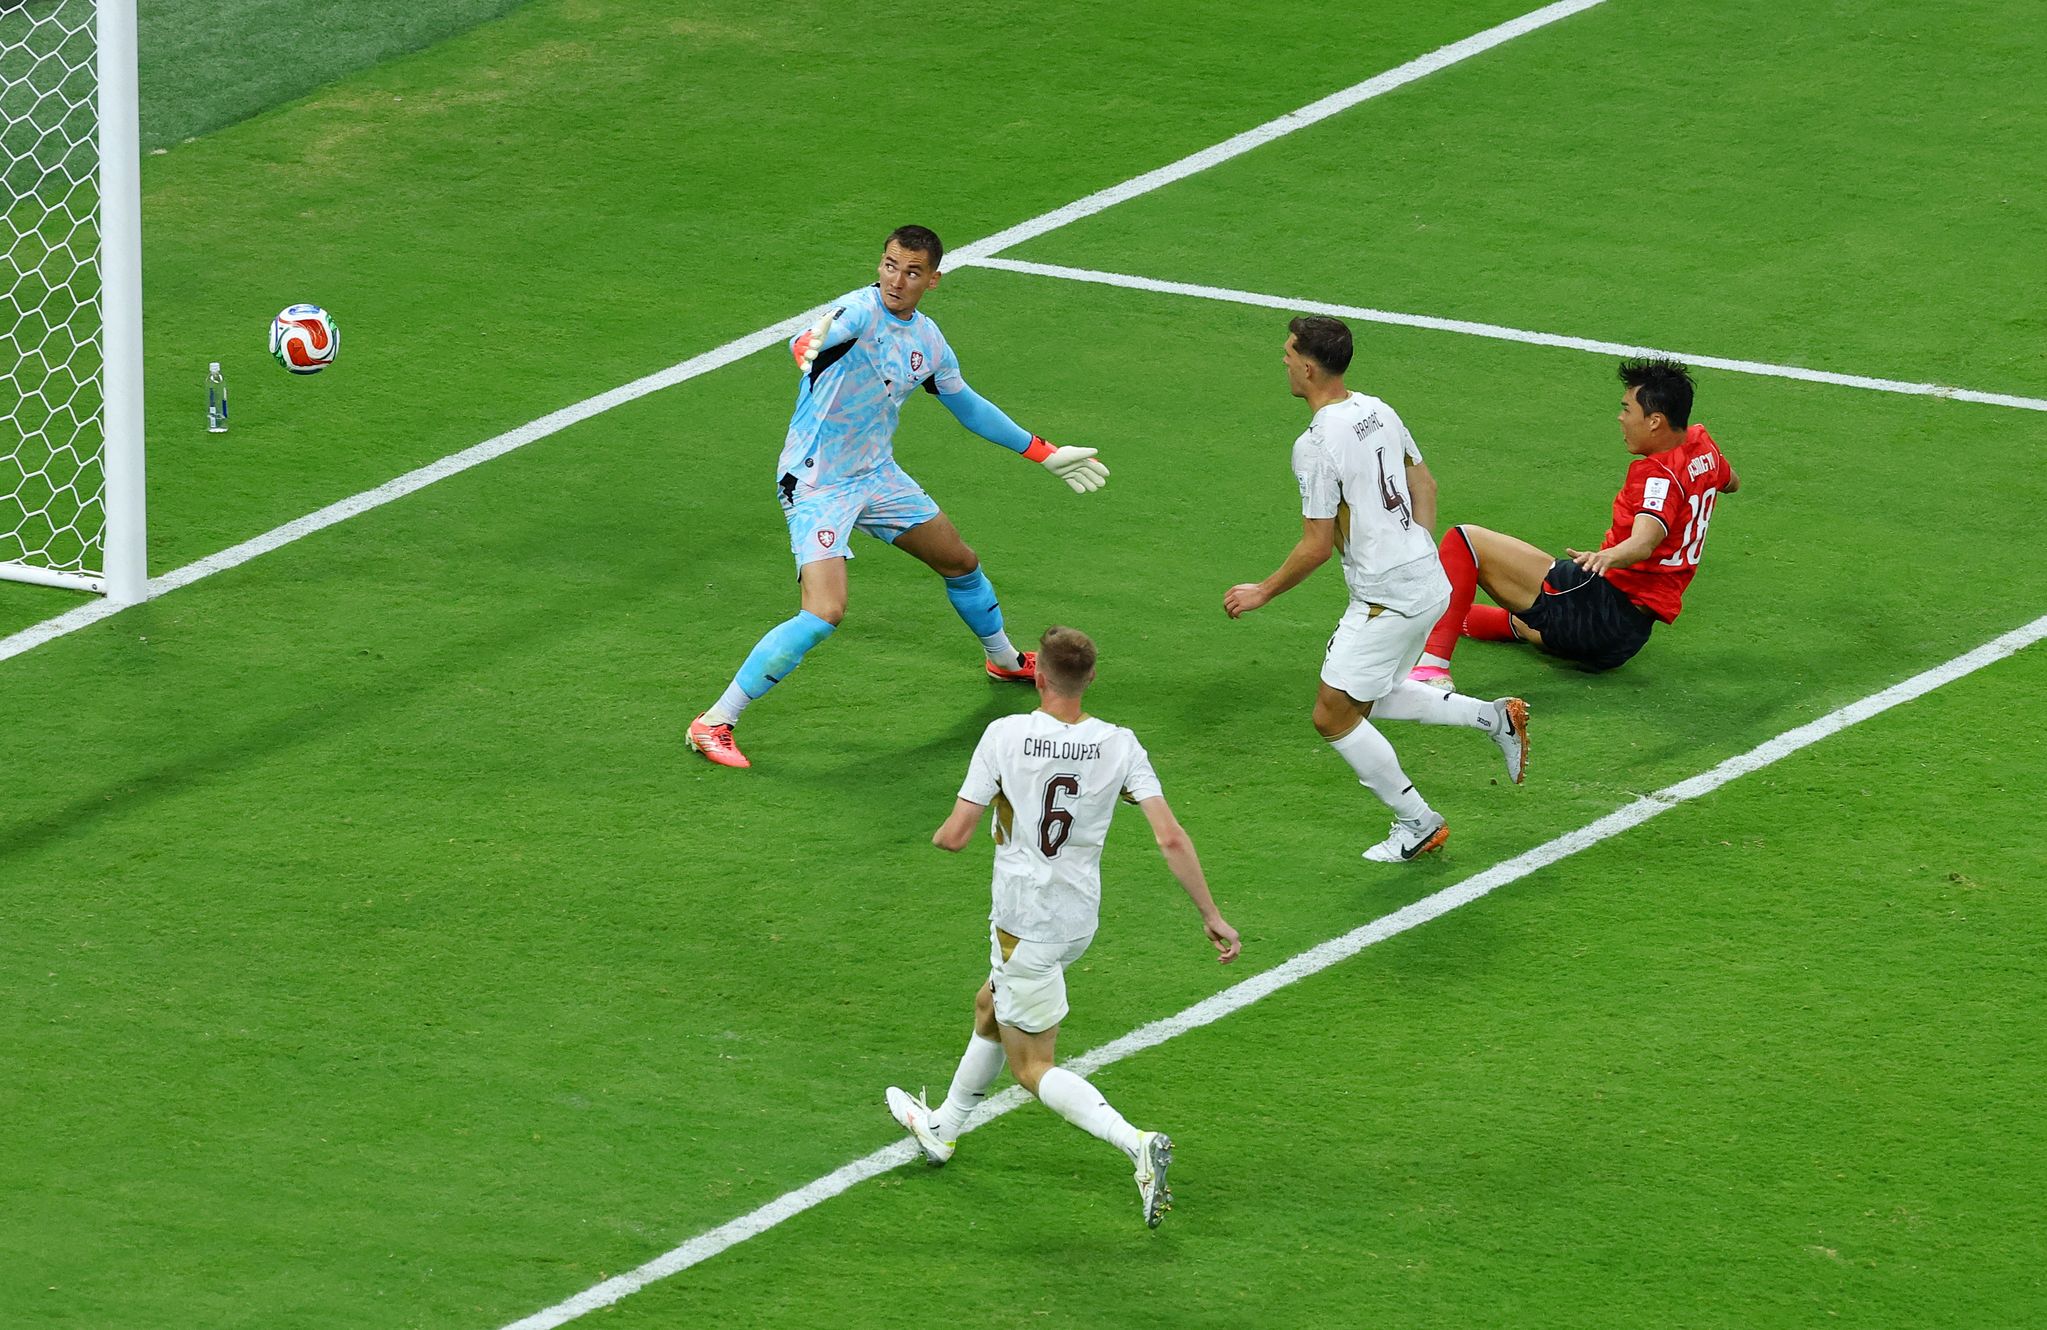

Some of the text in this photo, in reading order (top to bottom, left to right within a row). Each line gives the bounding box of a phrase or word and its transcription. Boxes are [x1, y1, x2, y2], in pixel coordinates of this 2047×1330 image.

[1375, 446, 1411, 531] 4
[1659, 487, 1717, 567] 18
[1023, 737, 1101, 762] CHALOUPEK
[1037, 773, 1082, 861] 6
